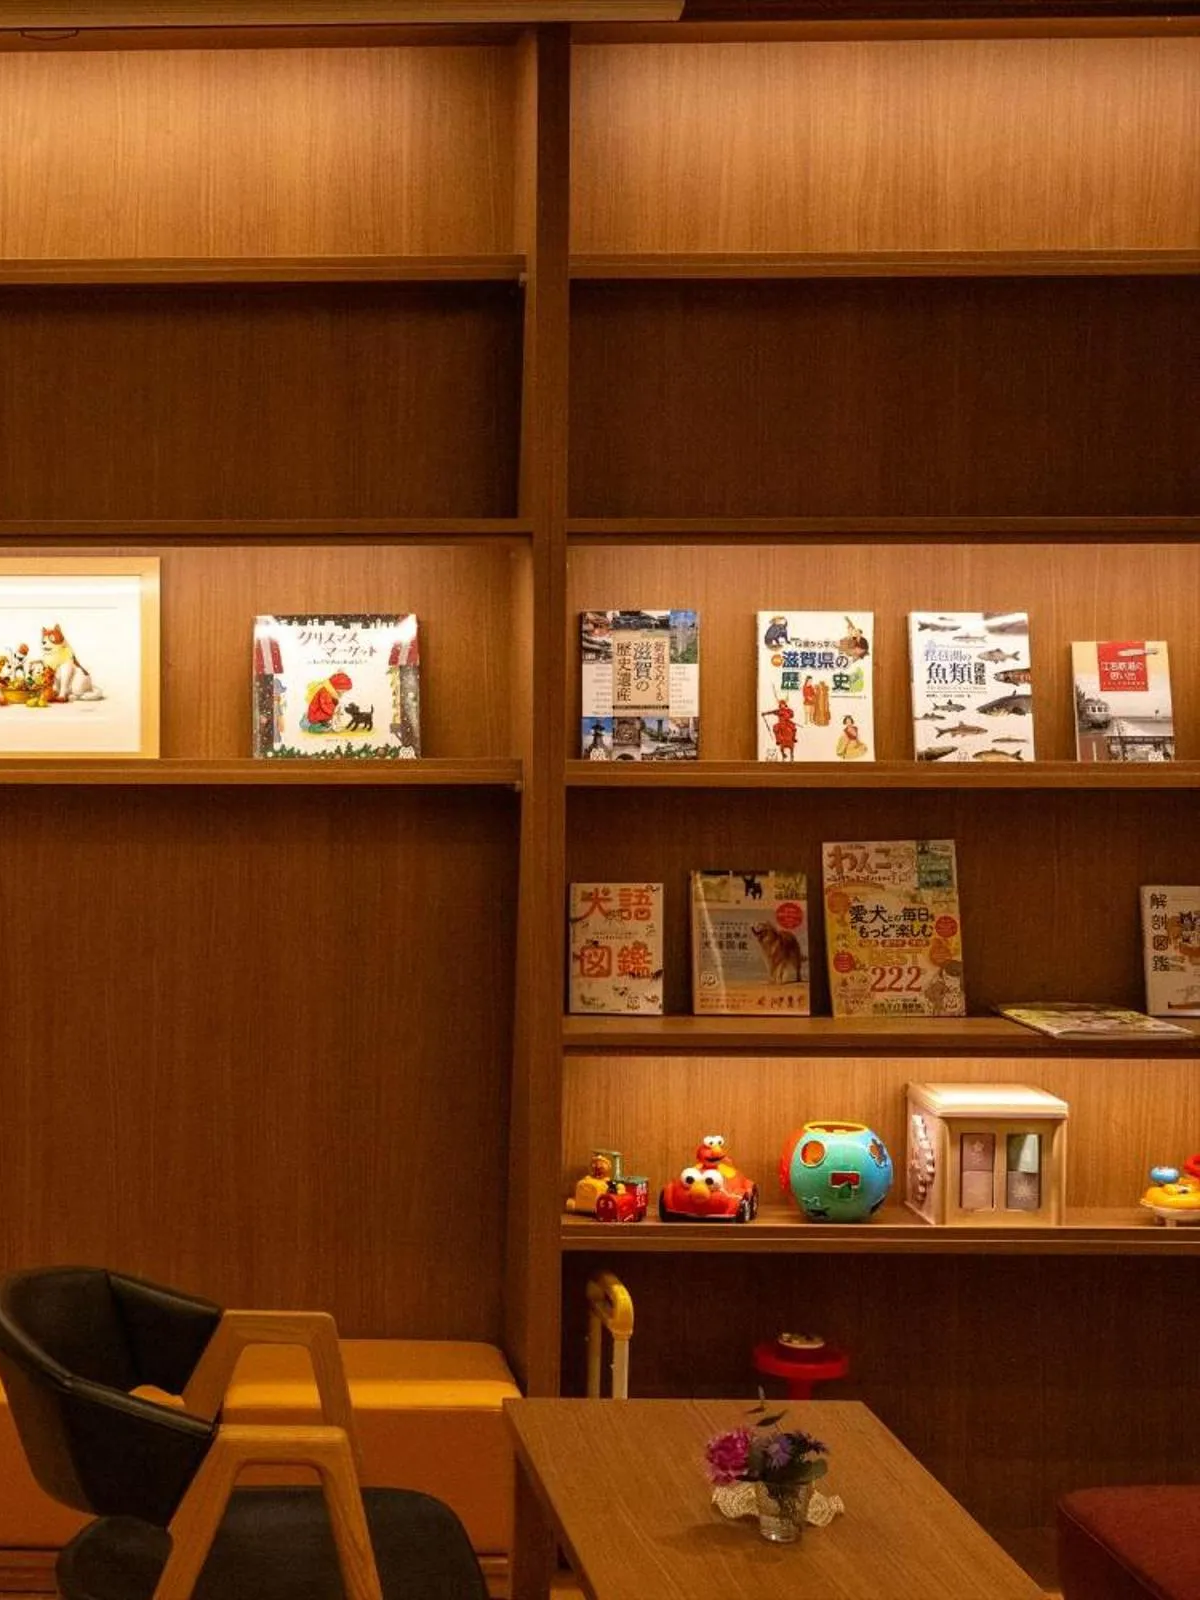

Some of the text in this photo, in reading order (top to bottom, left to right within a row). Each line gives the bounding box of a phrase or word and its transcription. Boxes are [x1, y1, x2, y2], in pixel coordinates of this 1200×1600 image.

[782, 651, 849, 669] 滋賀県の
[926, 662, 973, 685] 魚類
[1150, 893, 1170, 972] 解剖図鑑
[870, 965, 922, 993] 222
